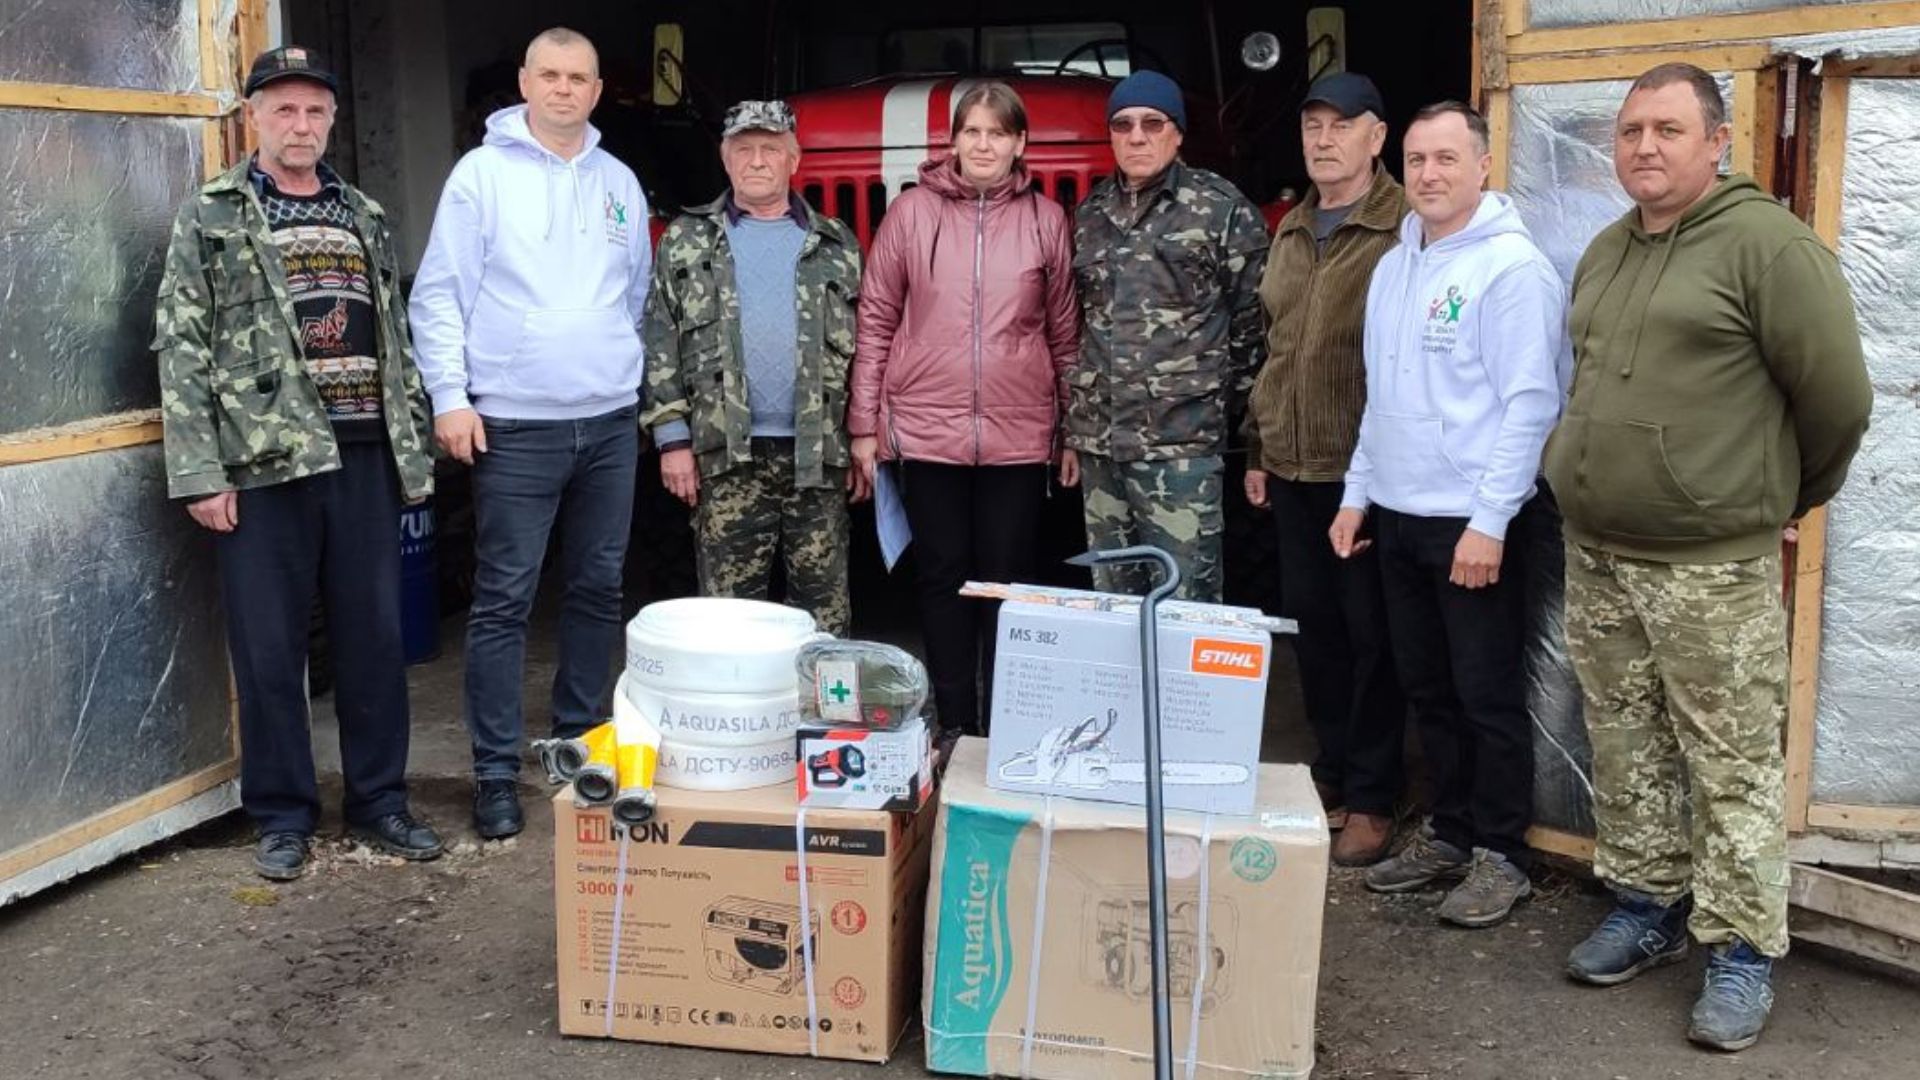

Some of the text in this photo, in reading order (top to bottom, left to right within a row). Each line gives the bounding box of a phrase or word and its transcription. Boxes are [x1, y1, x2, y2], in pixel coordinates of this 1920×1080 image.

[1010, 627, 1031, 641] MS
[1199, 649, 1256, 669] STIHL
[679, 713, 770, 733] AQUASILA
[808, 834, 840, 847] AVR
[1242, 849, 1267, 868] 12
[954, 862, 990, 1011] Aquatica
